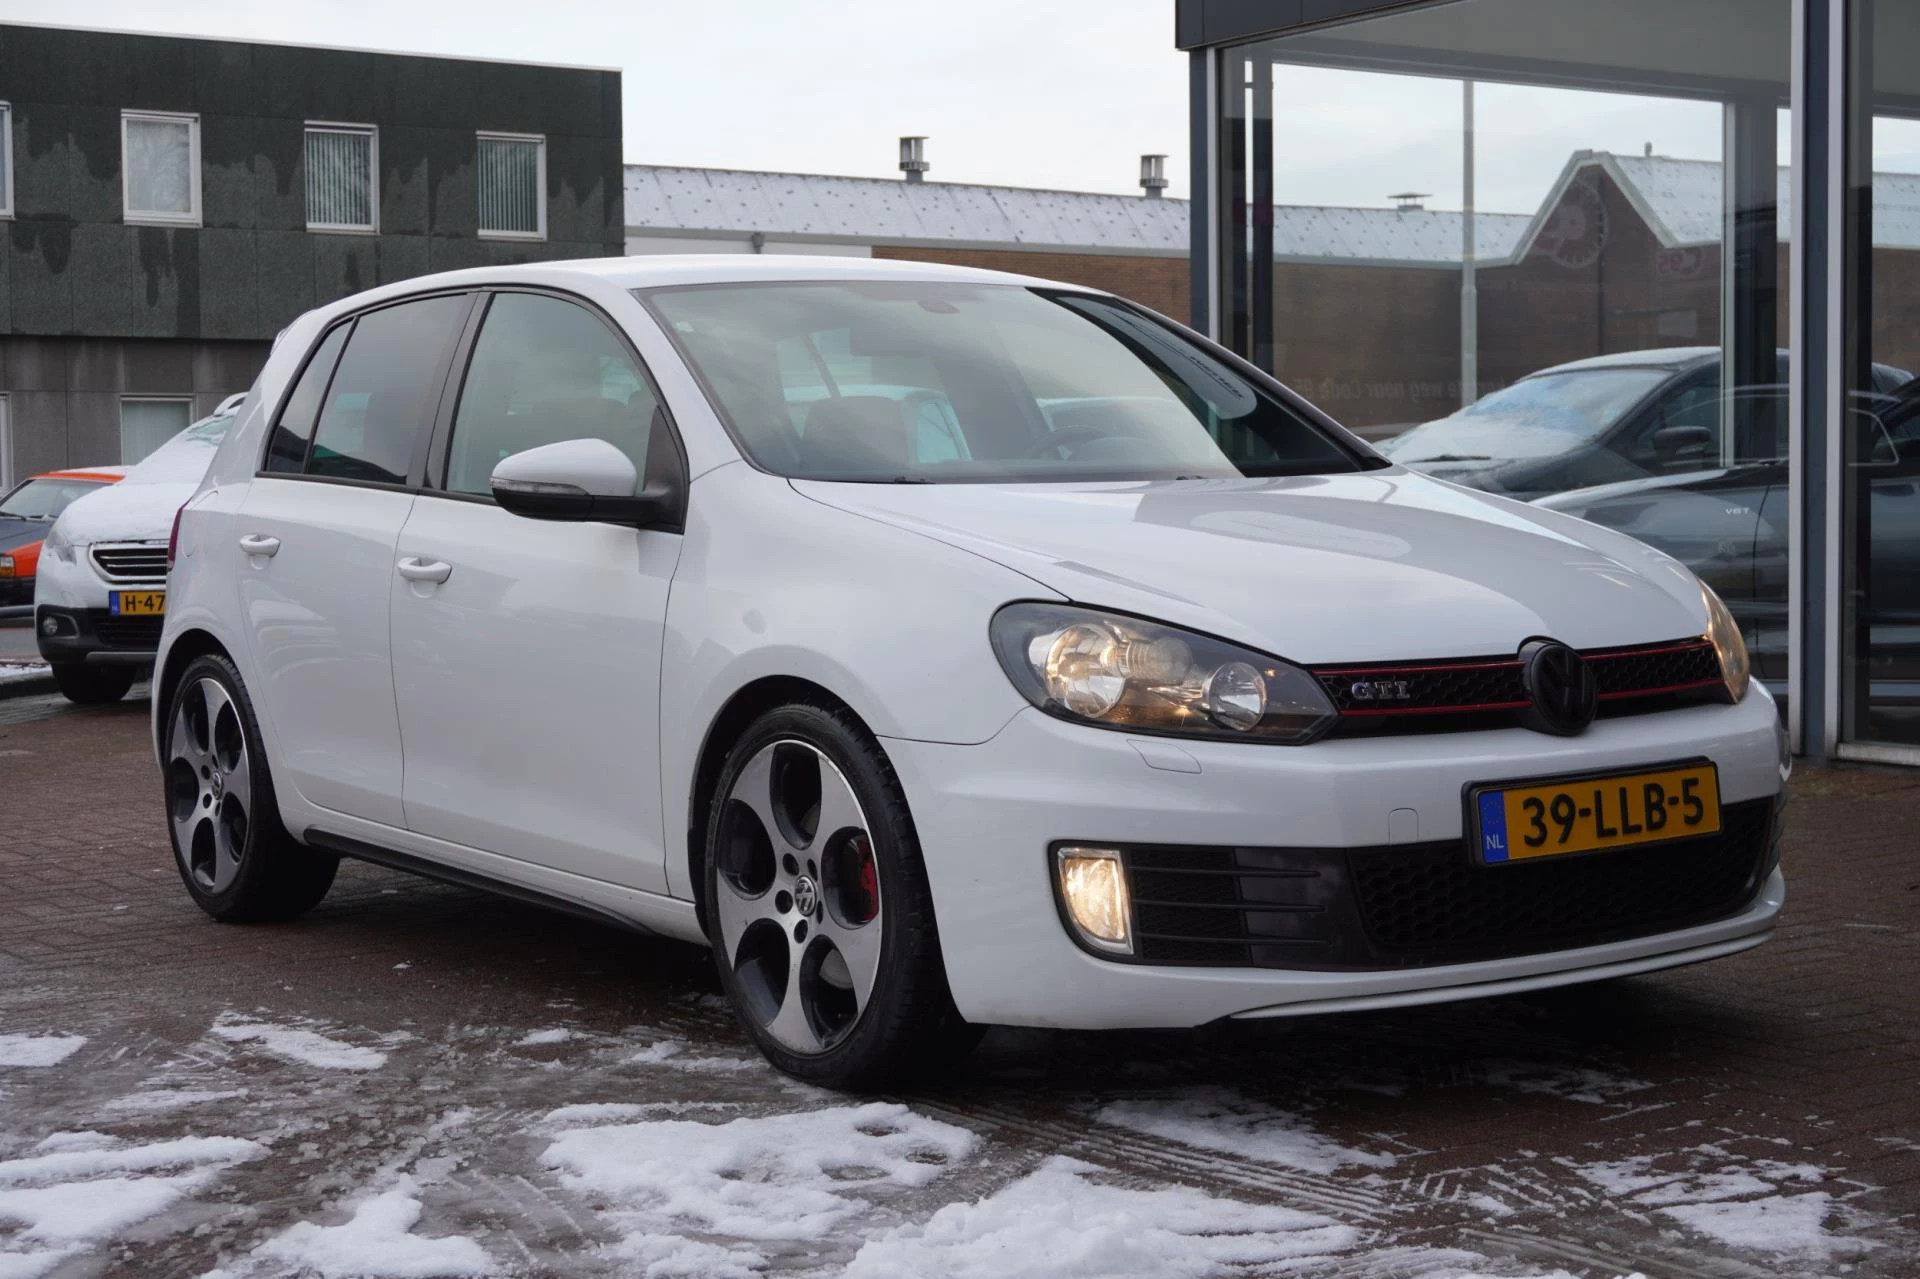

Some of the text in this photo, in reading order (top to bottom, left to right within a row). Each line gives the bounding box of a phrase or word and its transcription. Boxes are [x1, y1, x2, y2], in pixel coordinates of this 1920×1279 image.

[125, 595, 165, 611] H-47
[1352, 681, 1410, 699] GTI
[1522, 777, 1703, 847] 39-LLB-5
[1486, 834, 1504, 849] NL
